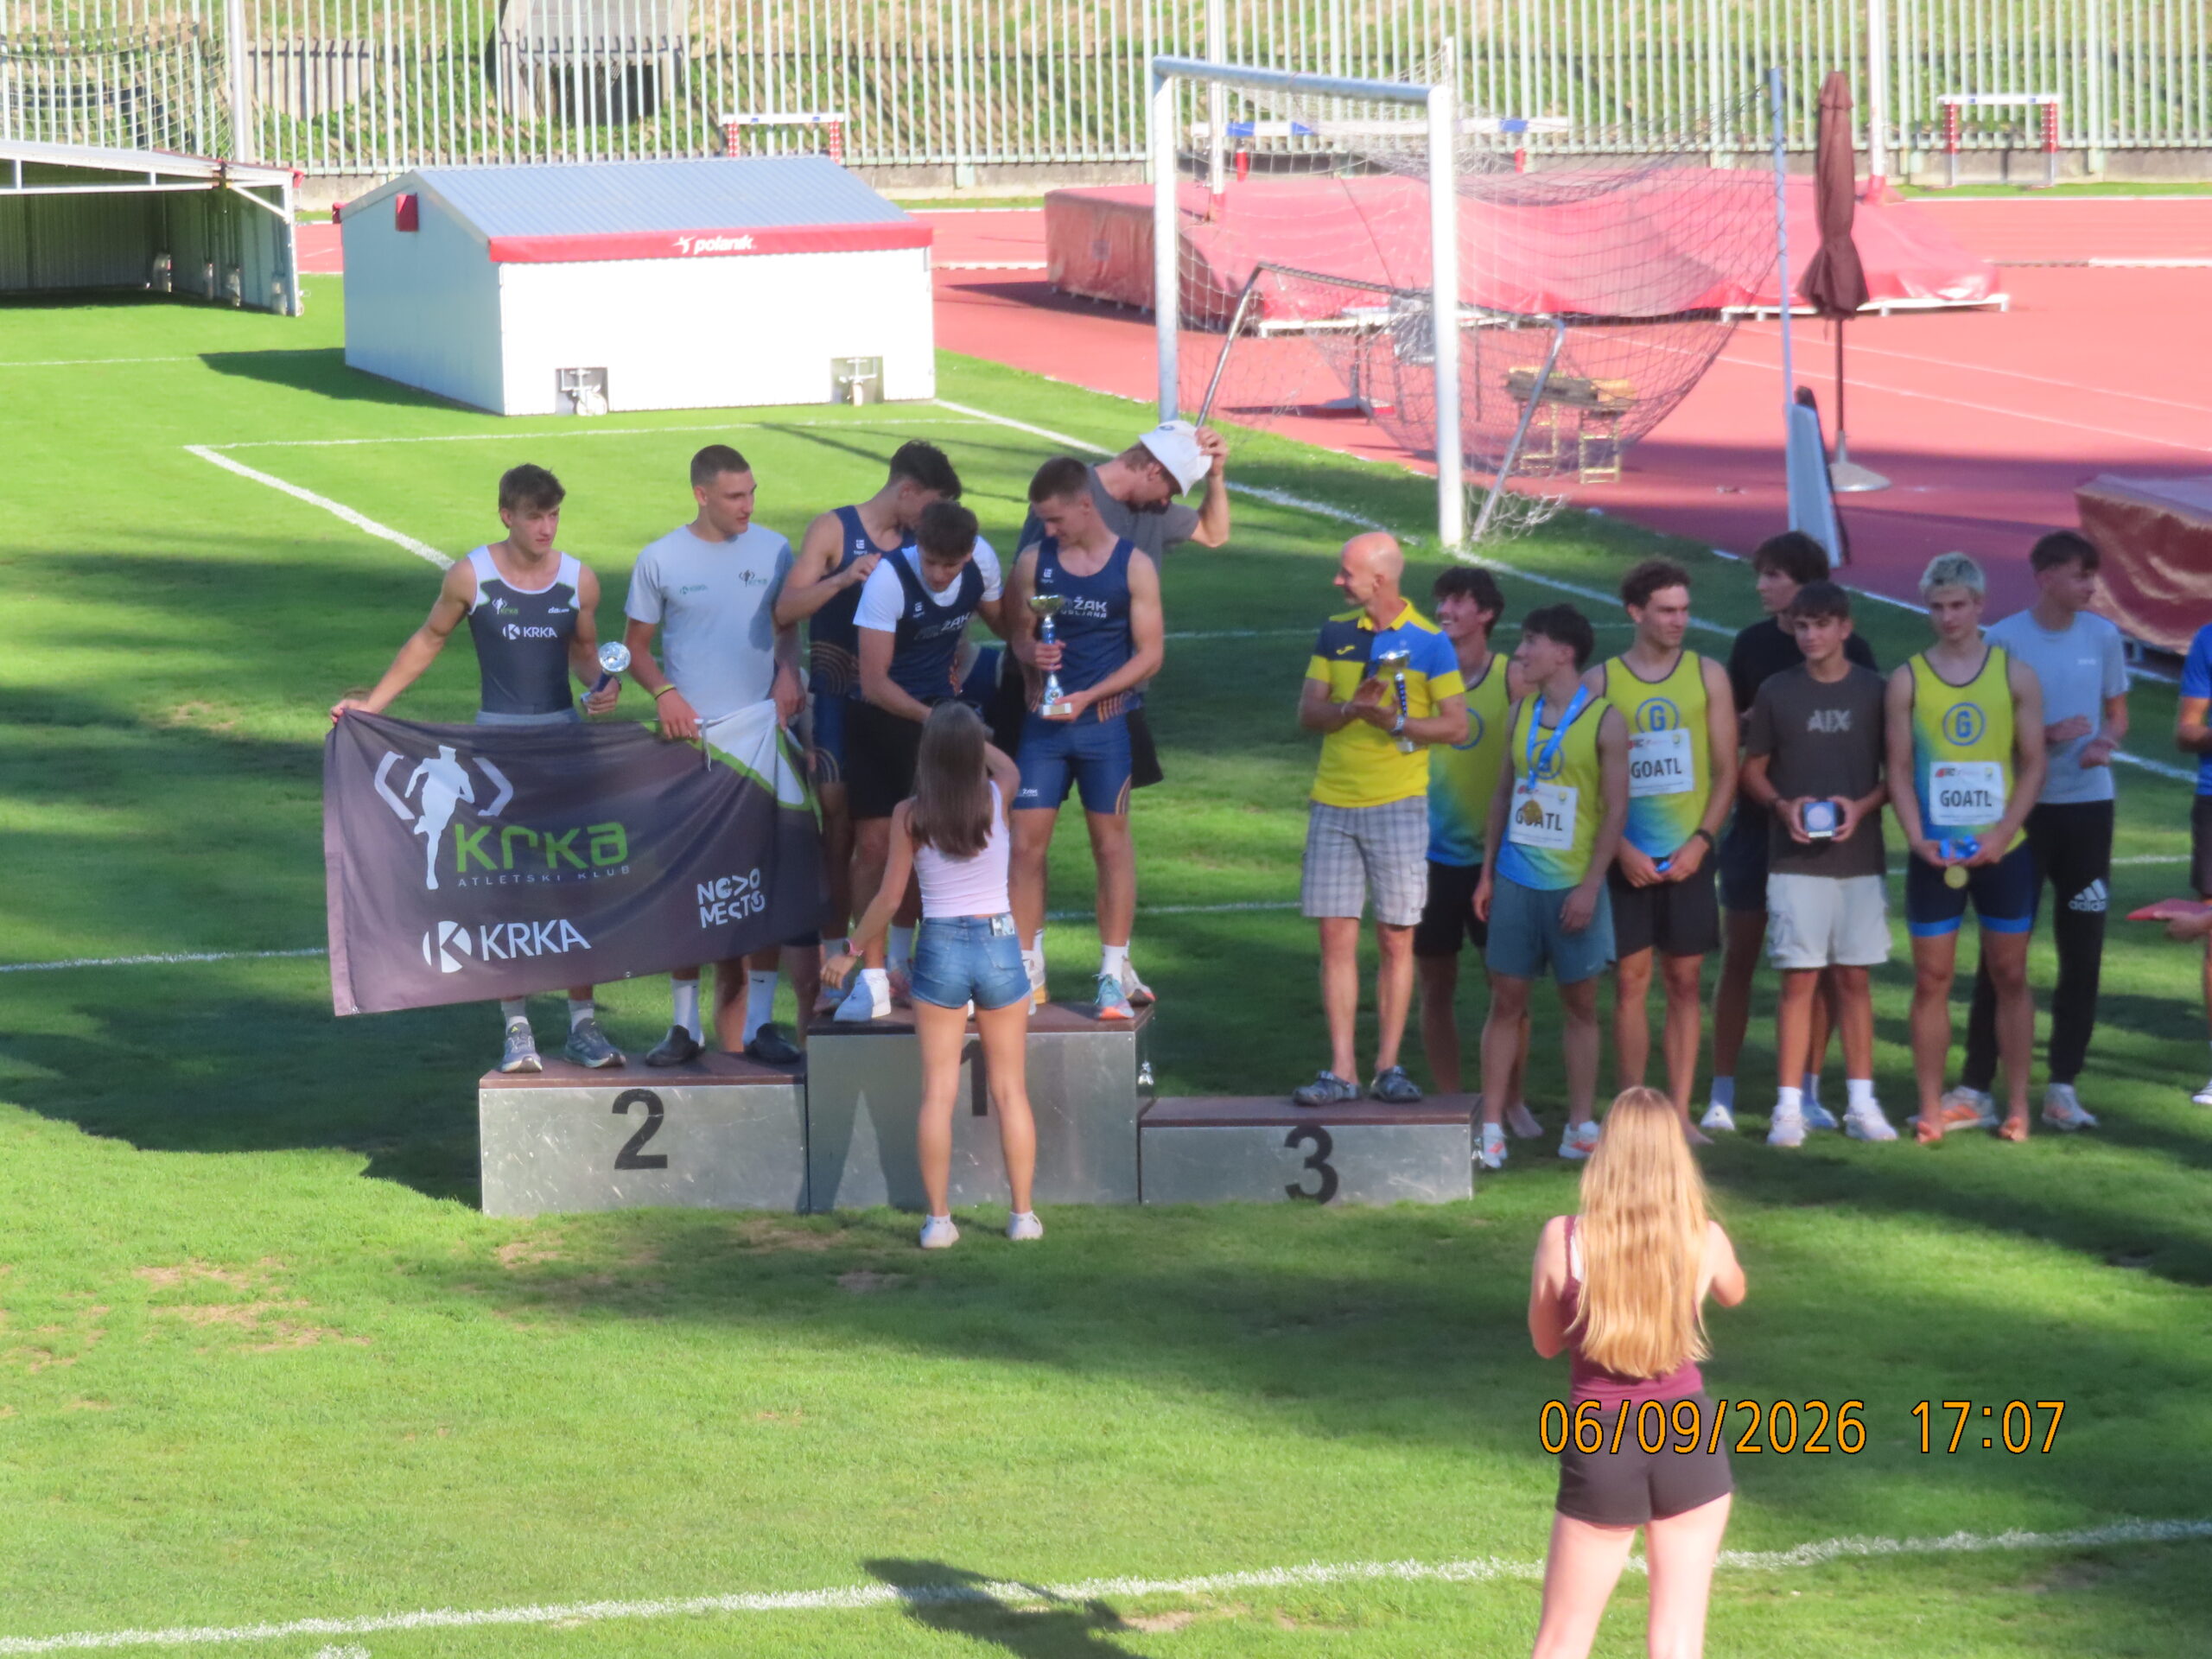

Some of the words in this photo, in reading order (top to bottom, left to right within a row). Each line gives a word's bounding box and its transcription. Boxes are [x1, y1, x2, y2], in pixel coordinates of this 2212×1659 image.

[1060, 609, 1107, 618] UBLJANA
[523, 626, 557, 638] KRKA
[1630, 758, 1682, 779] GOATL
[1940, 790, 1993, 808] GOATL
[458, 874, 561, 887] ATLETSKI
[578, 865, 630, 880] KLUB
[480, 918, 591, 962] KRKA
[960, 1039, 988, 1116] 1
[612, 1089, 668, 1170] 2
[1284, 1124, 1338, 1204] 3
